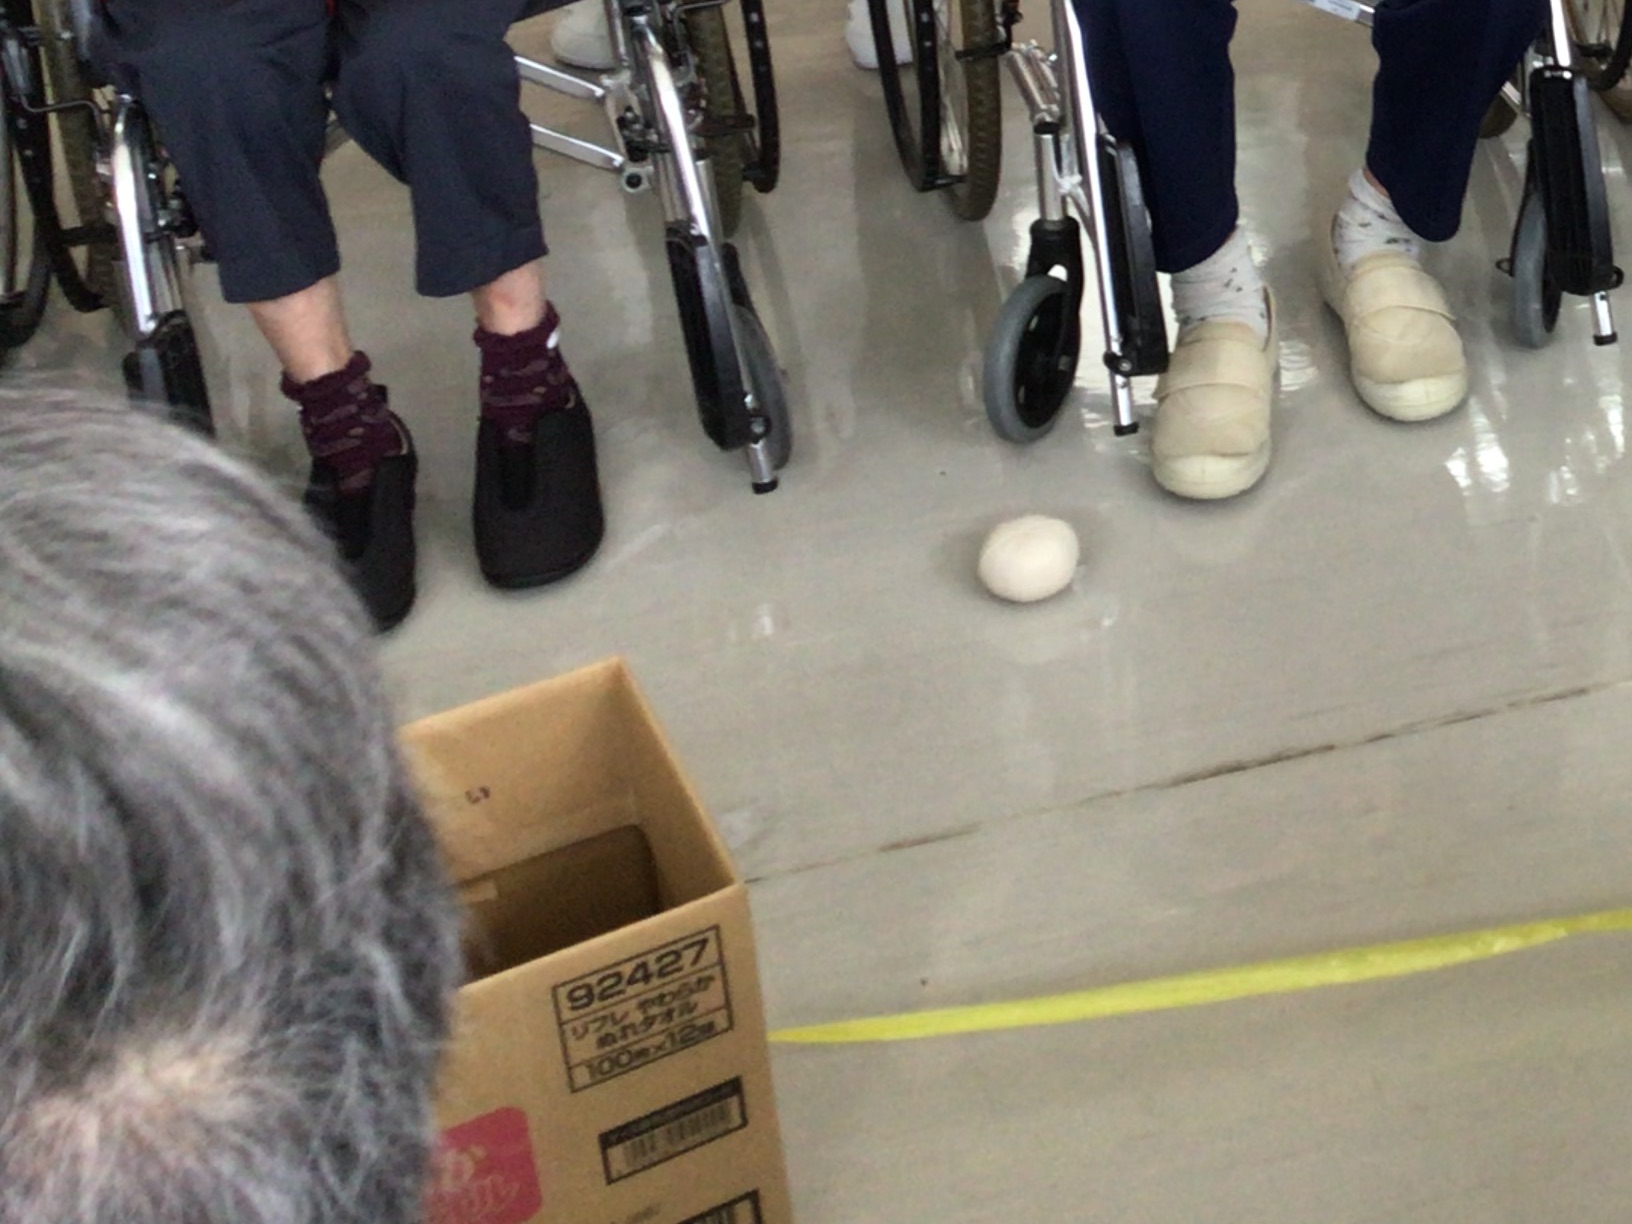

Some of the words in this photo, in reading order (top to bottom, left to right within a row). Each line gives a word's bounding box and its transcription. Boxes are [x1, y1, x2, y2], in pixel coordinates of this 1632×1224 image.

[566, 937, 709, 1012] 92427
[571, 1009, 630, 1041] リフレ
[596, 1000, 699, 1049] ぬれタオル
